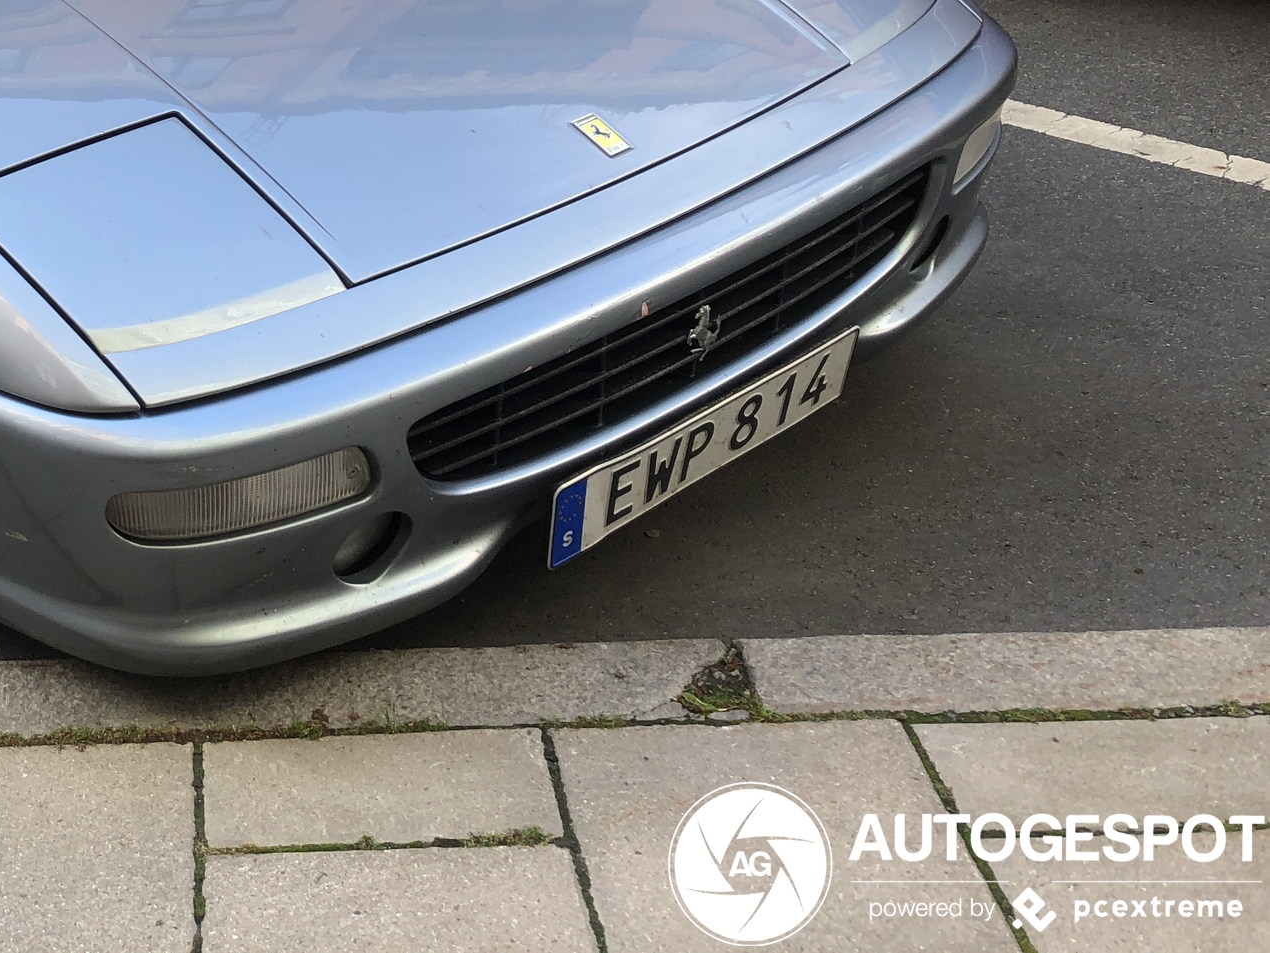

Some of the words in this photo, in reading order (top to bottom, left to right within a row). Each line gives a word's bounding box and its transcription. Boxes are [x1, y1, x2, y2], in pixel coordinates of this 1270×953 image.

[604, 421, 715, 528] EWP
[728, 352, 831, 451] 814
[562, 530, 574, 548] S
